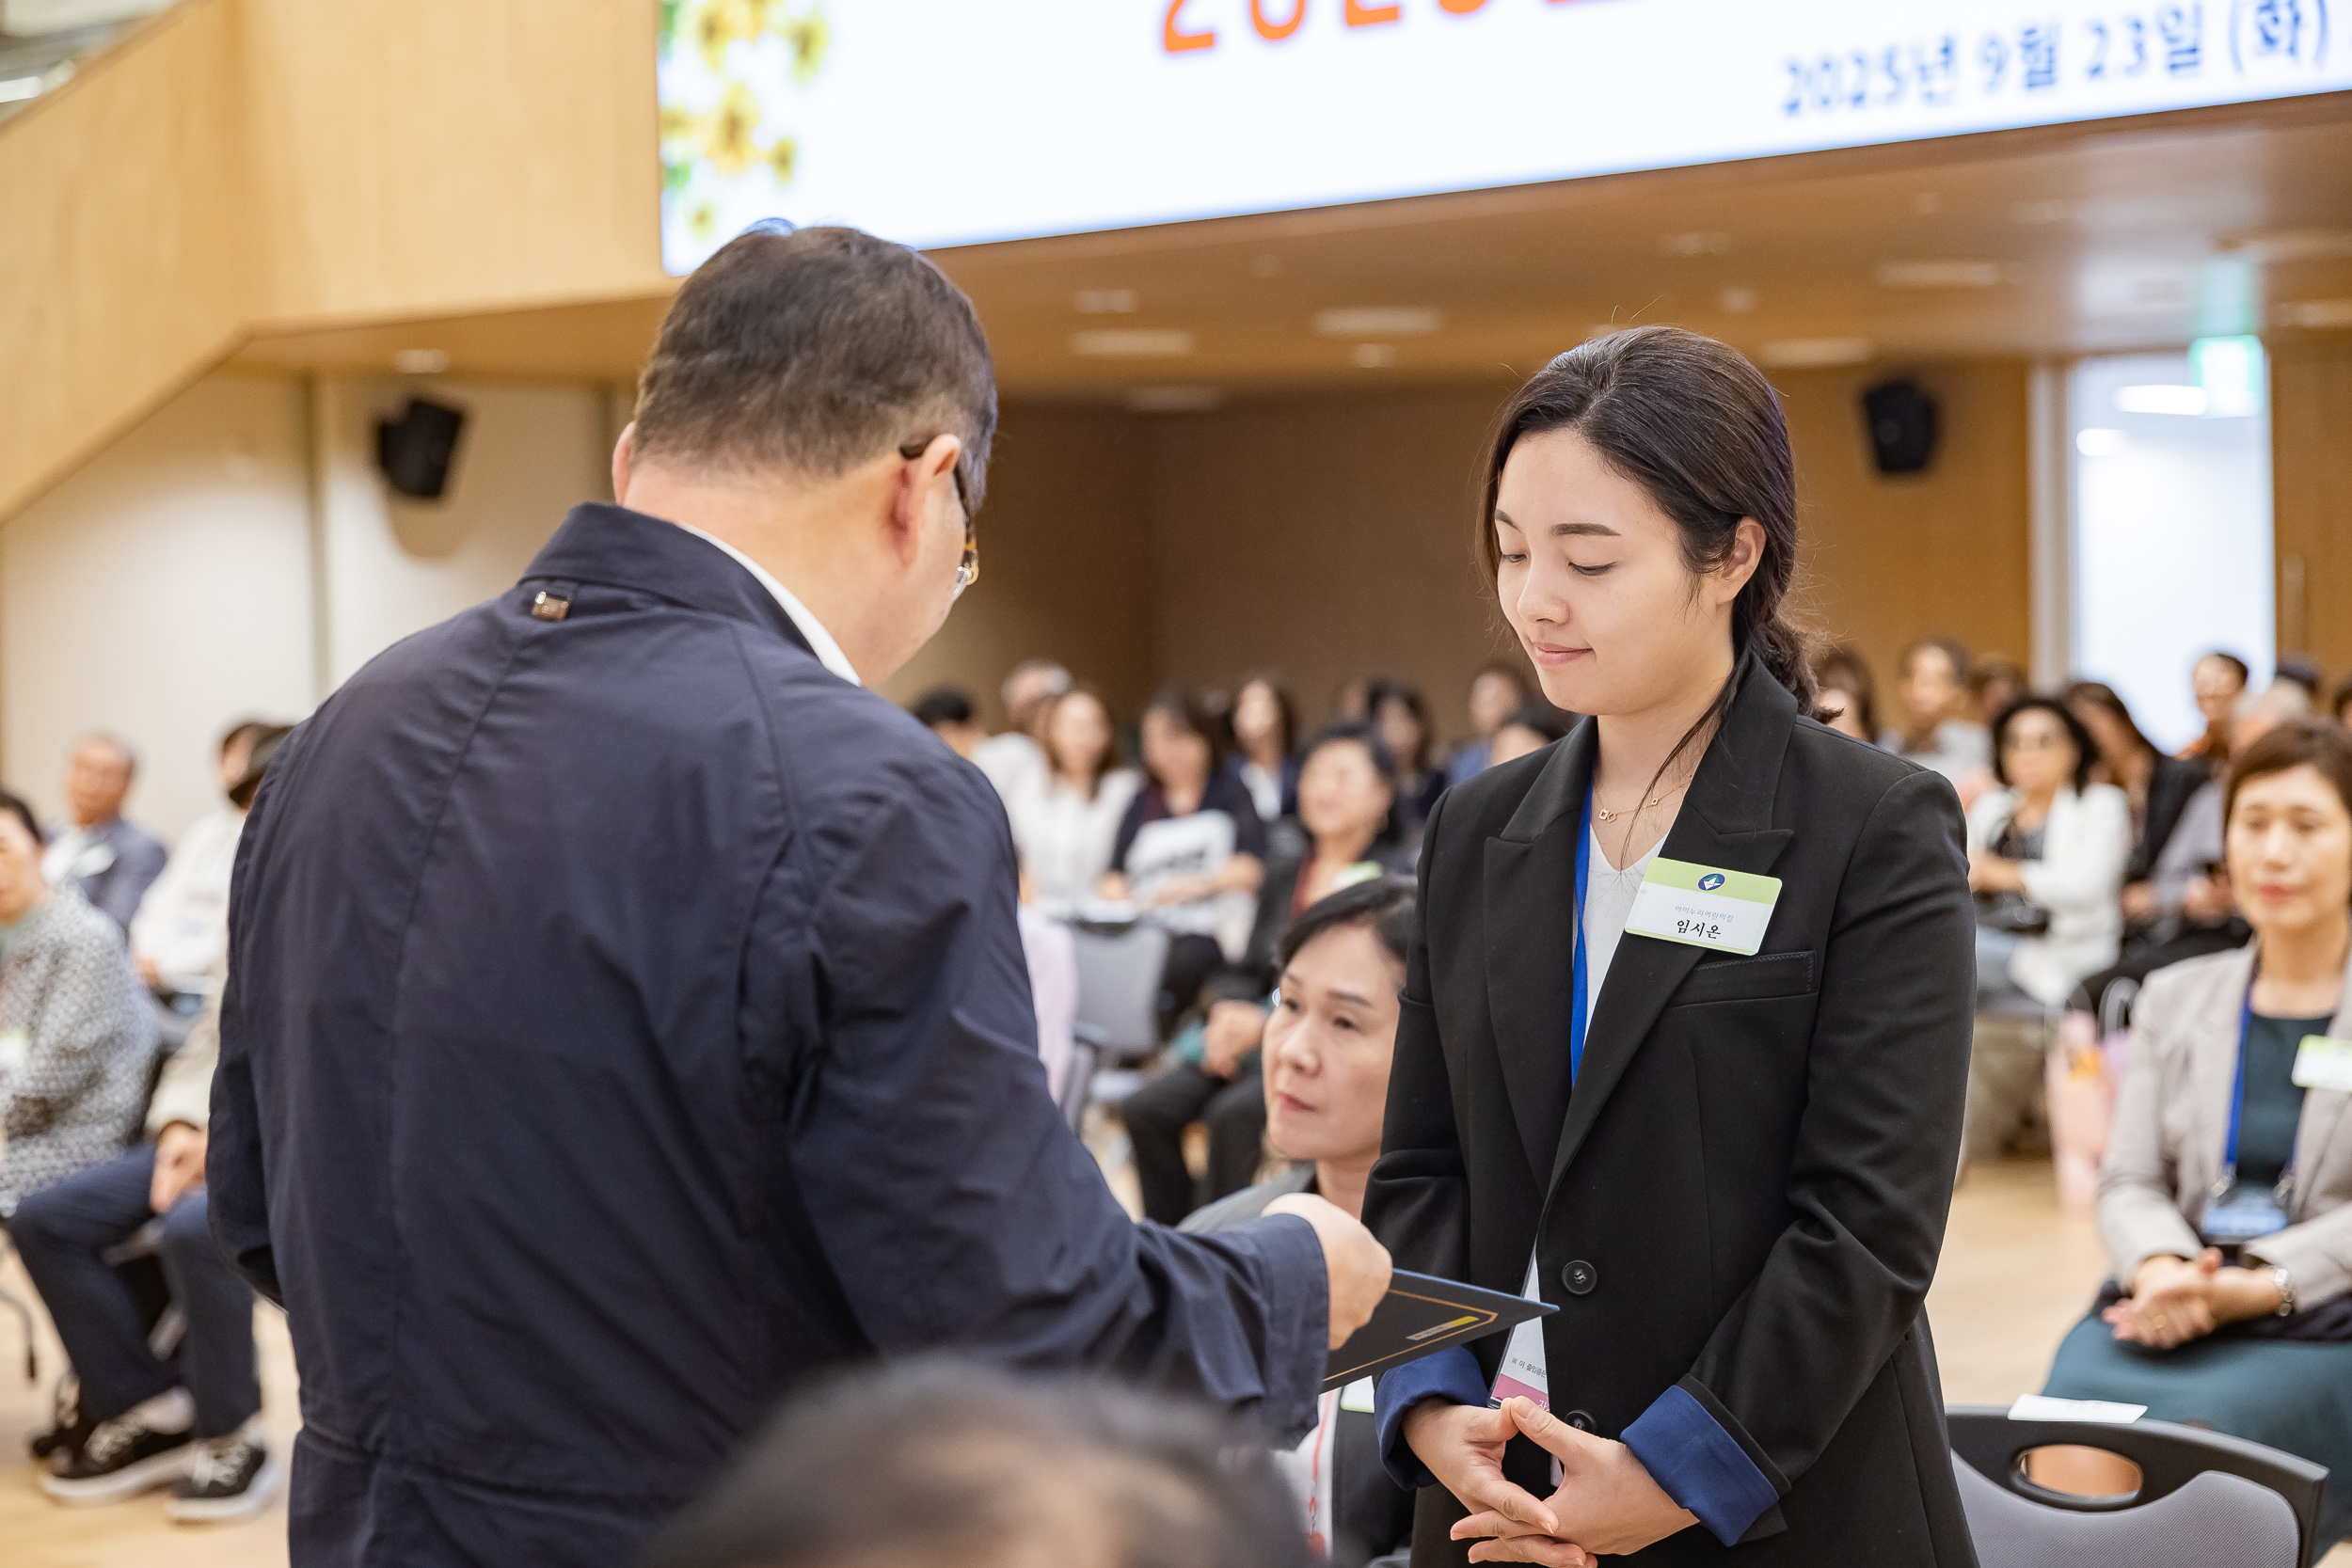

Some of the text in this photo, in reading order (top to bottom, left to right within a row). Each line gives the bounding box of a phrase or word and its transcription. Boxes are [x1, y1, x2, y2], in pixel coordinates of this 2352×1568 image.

[1783, 37, 1956, 114] 2025년
[1978, 22, 2061, 92] 9월
[2083, 4, 2201, 77] 23일
[1675, 906, 1734, 923] 아이누리어린이집
[1677, 919, 1721, 939] 임시온
